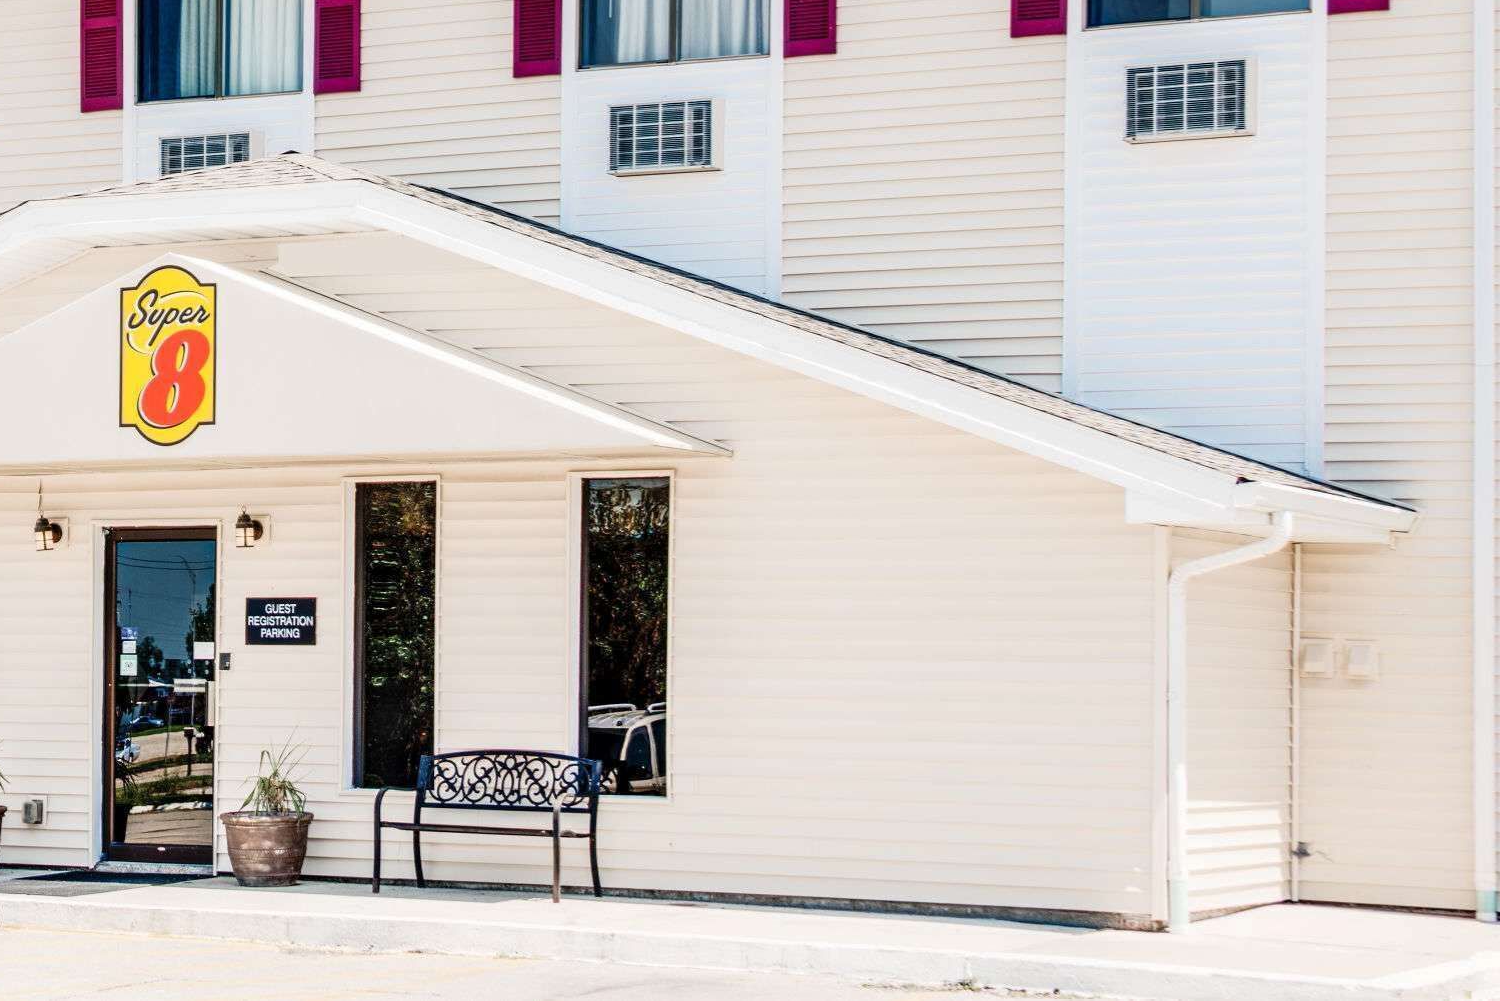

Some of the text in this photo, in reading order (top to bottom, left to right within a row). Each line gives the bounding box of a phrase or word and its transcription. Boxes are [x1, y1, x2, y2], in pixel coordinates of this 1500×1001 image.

[127, 288, 211, 347] Super
[136, 329, 211, 429] 8
[264, 603, 297, 614] GUEST
[247, 615, 314, 626] REGISTRATION
[260, 628, 301, 638] PARKING
